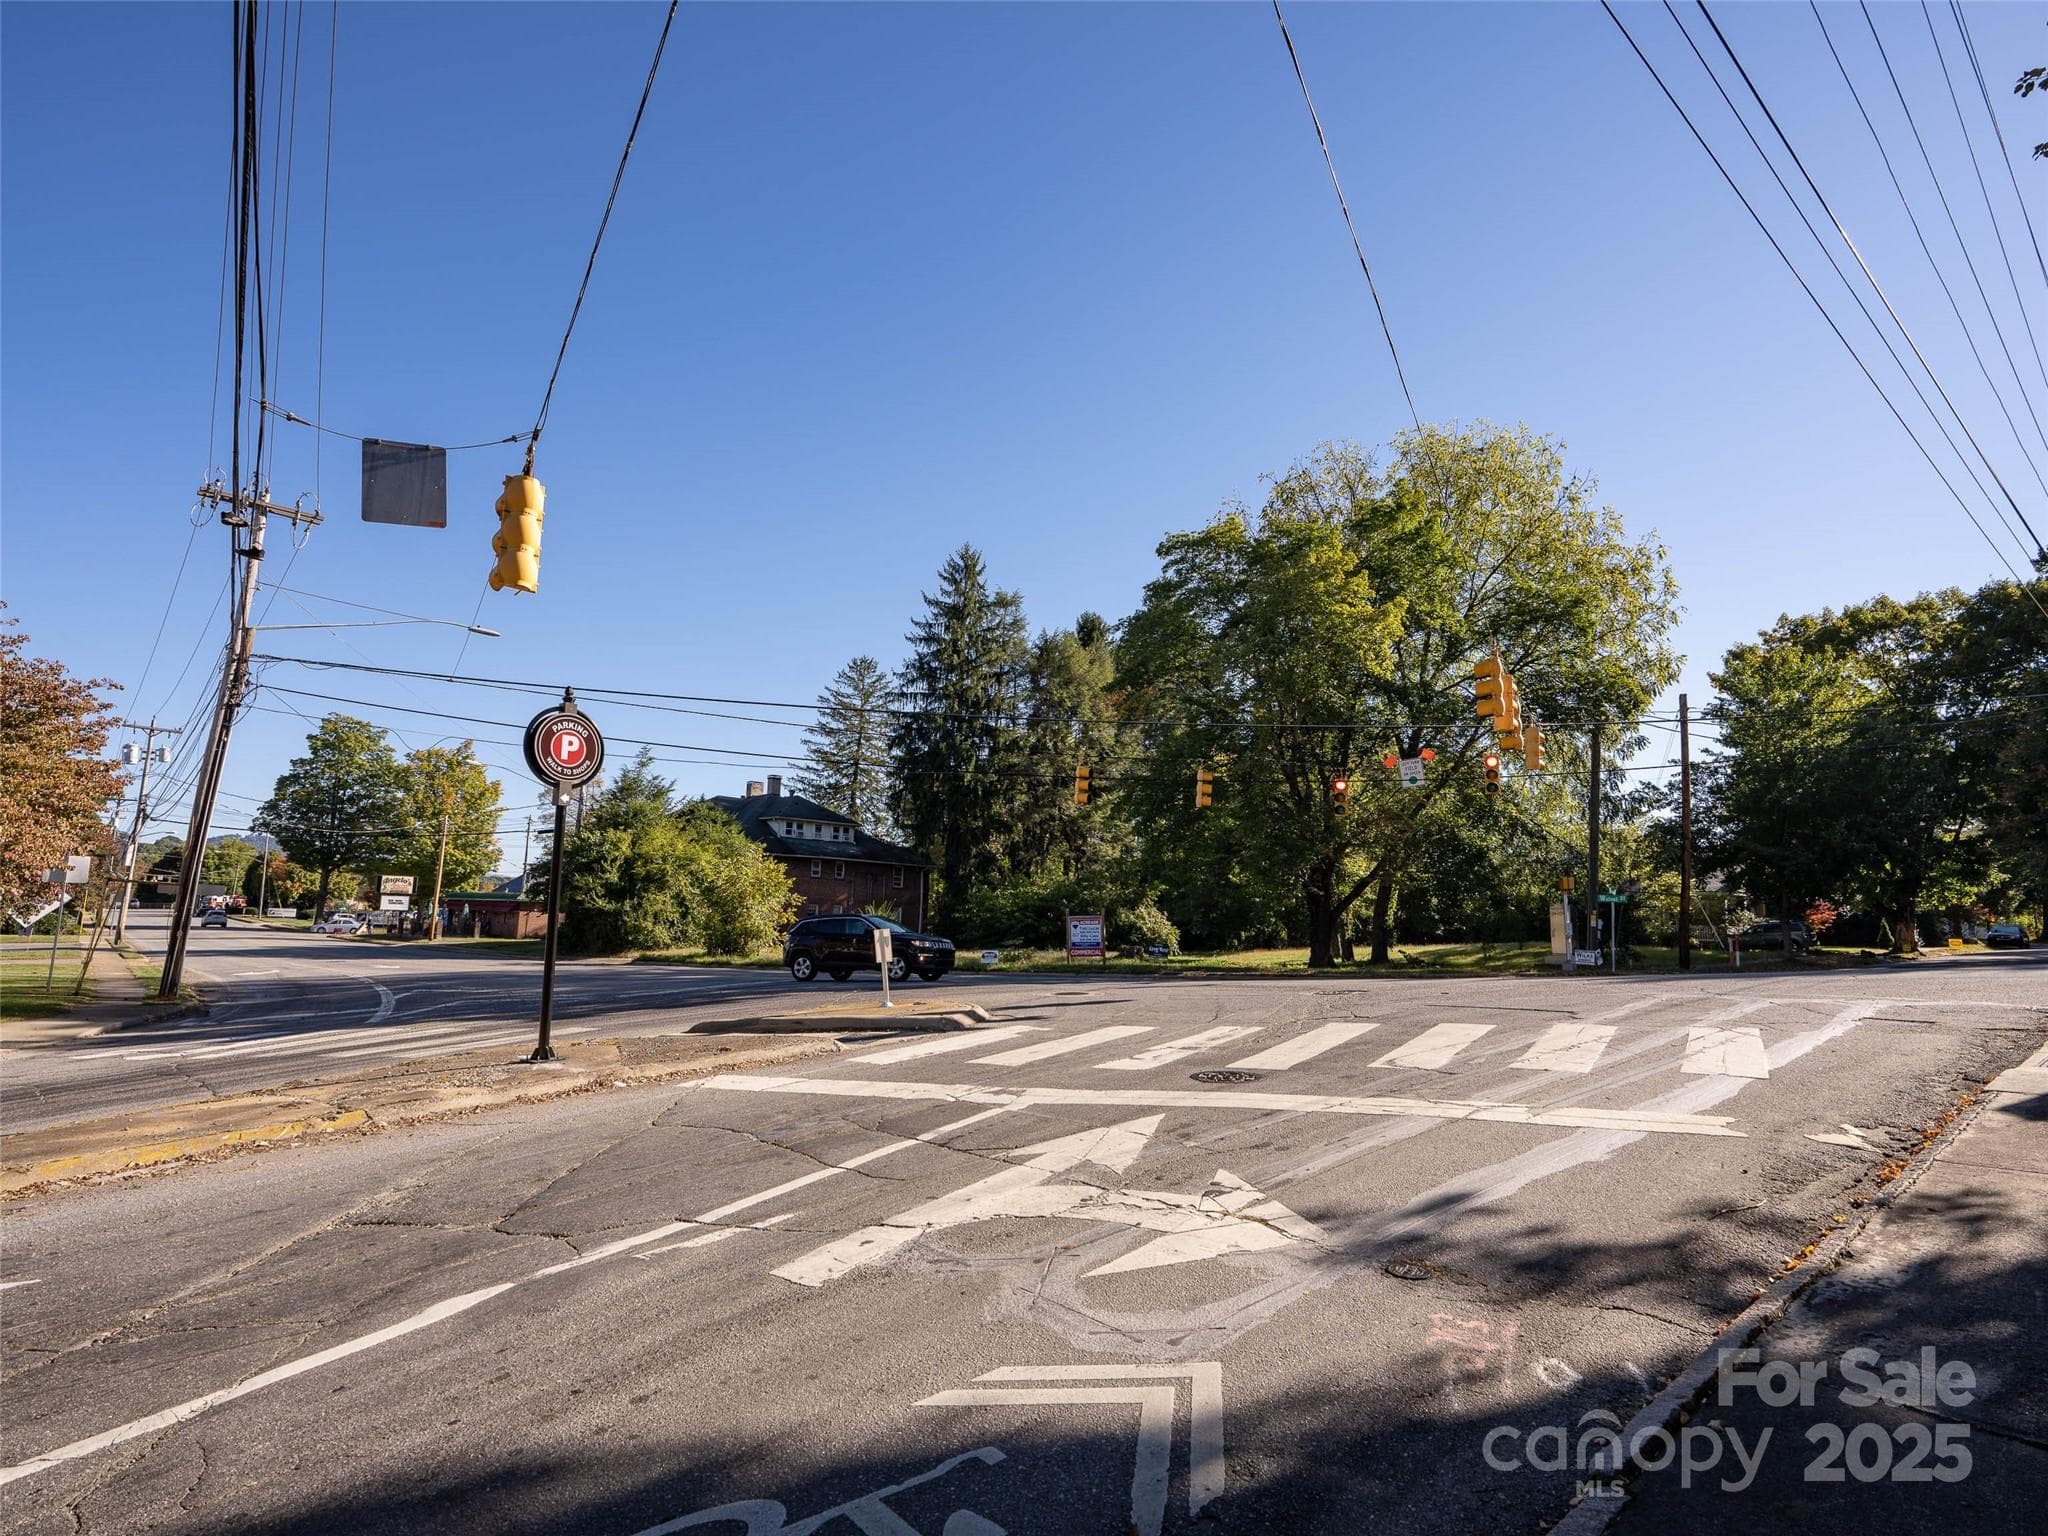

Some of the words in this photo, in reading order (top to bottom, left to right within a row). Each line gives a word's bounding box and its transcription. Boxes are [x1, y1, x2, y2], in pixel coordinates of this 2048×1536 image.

[551, 721, 589, 738] PARKING
[560, 734, 580, 760] P
[546, 756, 562, 773] WALK
[573, 760, 591, 775] SHOPS
